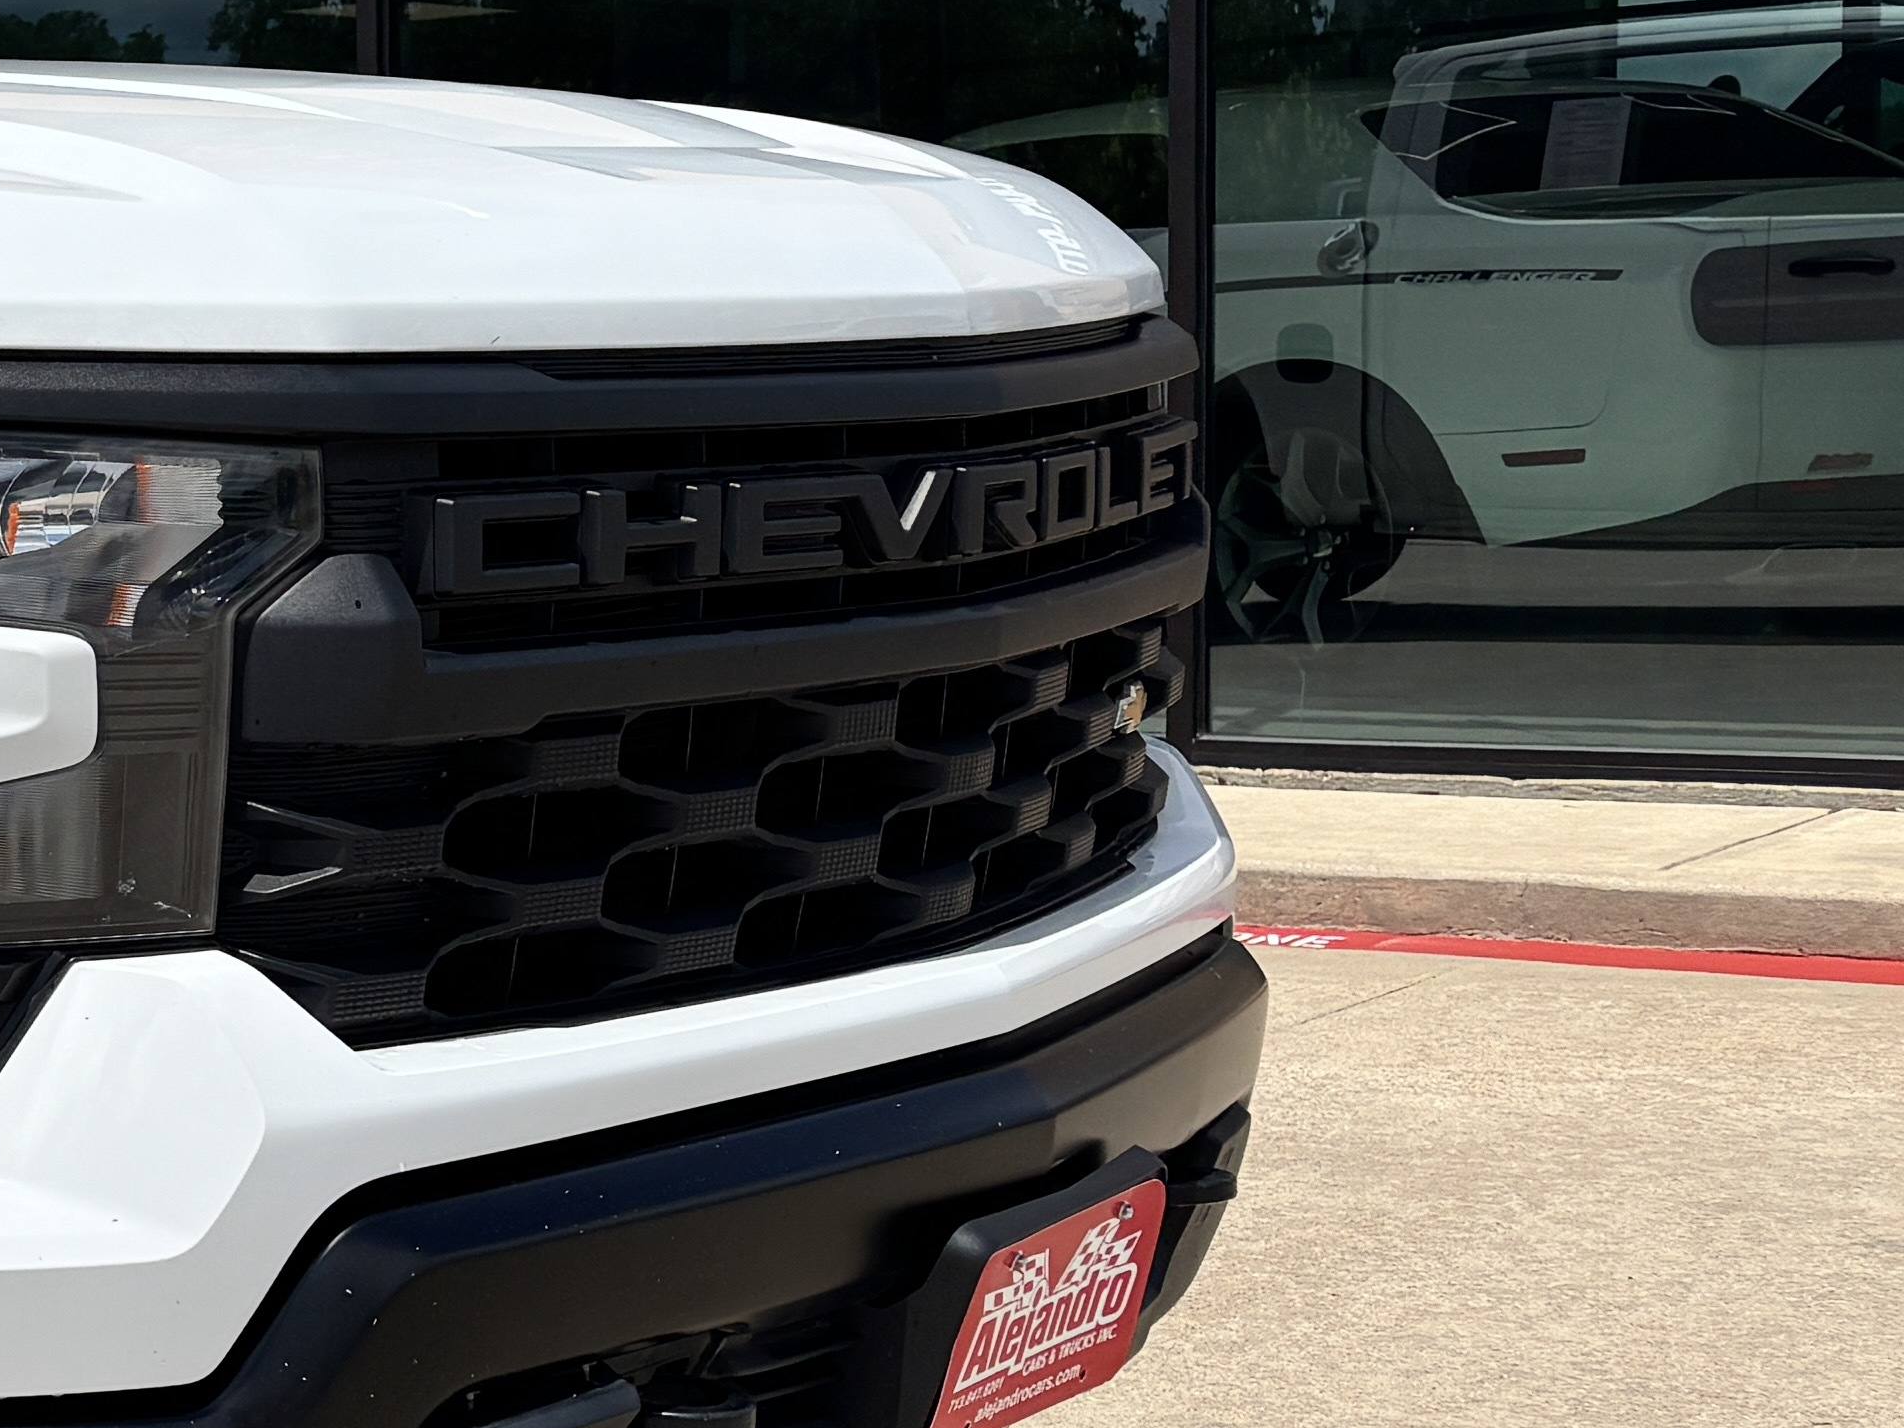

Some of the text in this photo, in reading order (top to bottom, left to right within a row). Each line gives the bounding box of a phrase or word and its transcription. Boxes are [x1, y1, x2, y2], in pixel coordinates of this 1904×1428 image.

[953, 1262, 1138, 1394] Alejandro
[1022, 1356, 1049, 1377] CARS
[1058, 1331, 1097, 1361] TRUCKS
[973, 1364, 1081, 1424] alejandrocars.com
